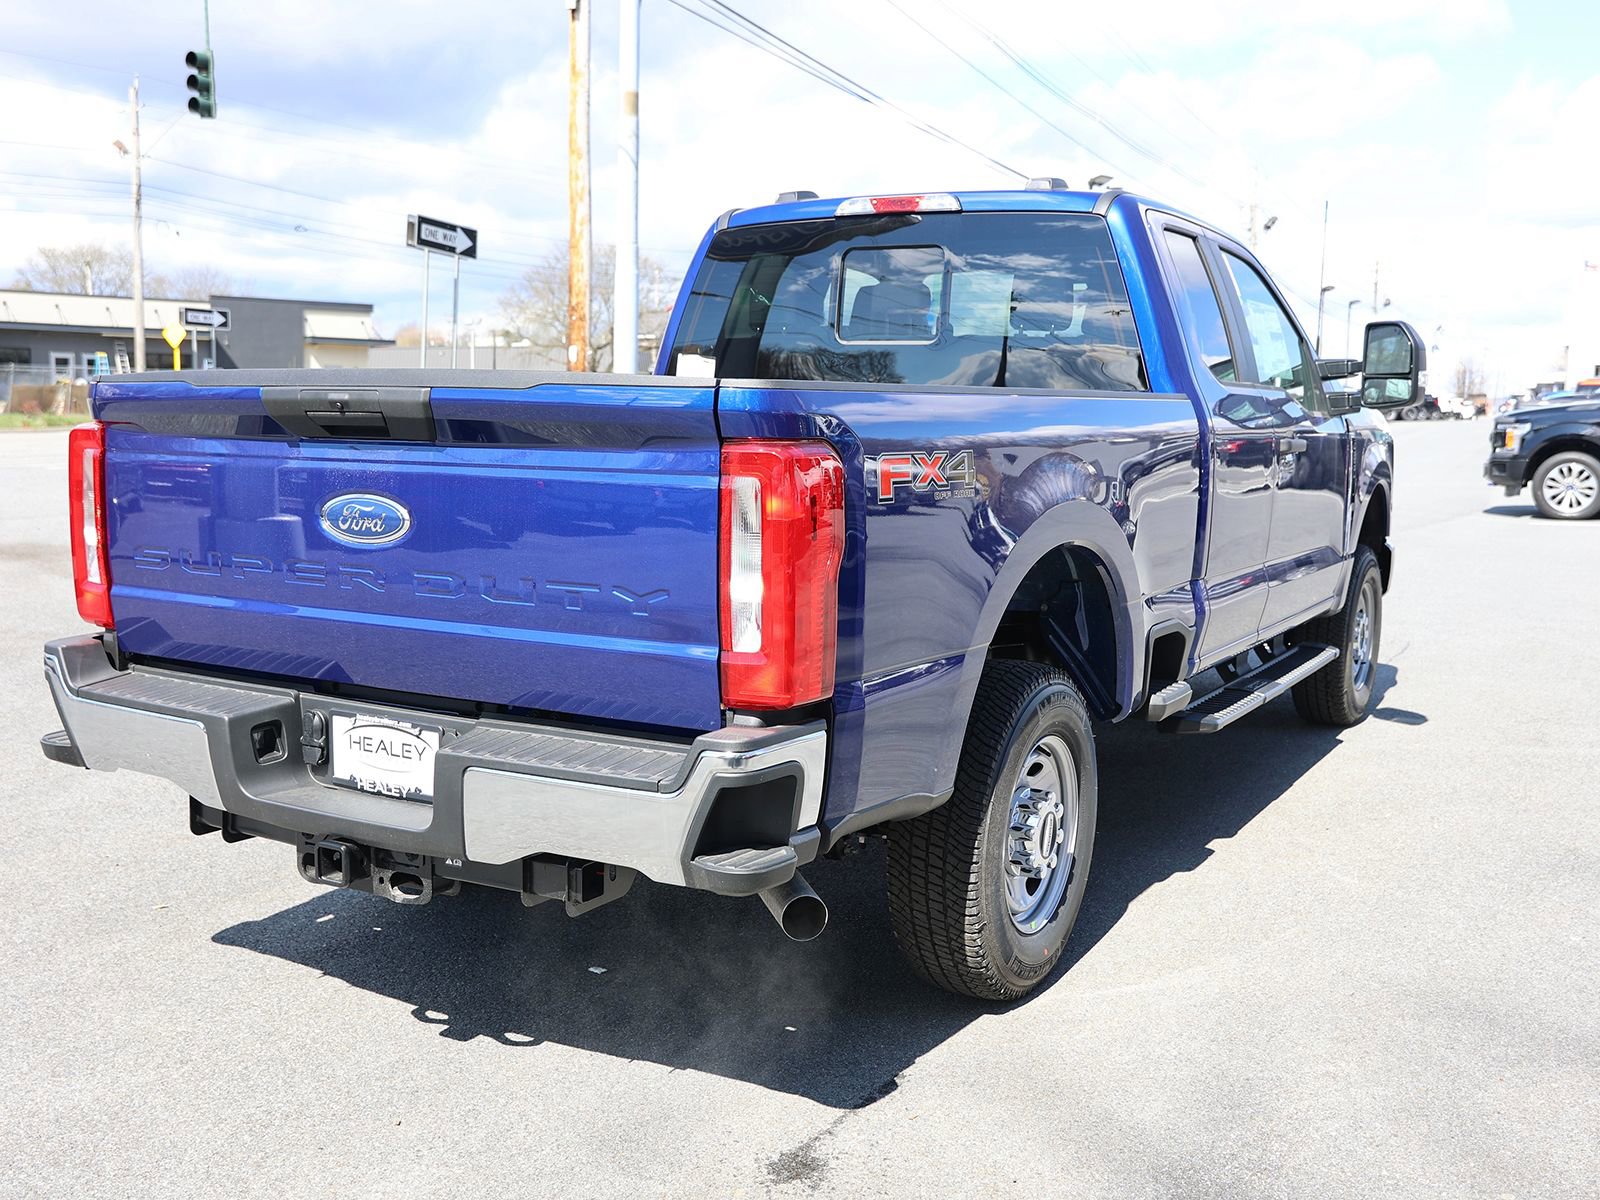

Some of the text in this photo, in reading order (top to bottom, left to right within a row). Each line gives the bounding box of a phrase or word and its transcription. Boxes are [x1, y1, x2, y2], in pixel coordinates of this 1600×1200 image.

[424, 228, 457, 243] ONE WAY
[877, 450, 976, 504] FX4
[338, 503, 387, 532] Ford
[133, 547, 671, 617] SUPER DUTY
[349, 734, 426, 761] HEALEY
[357, 778, 411, 798] HEALEY
